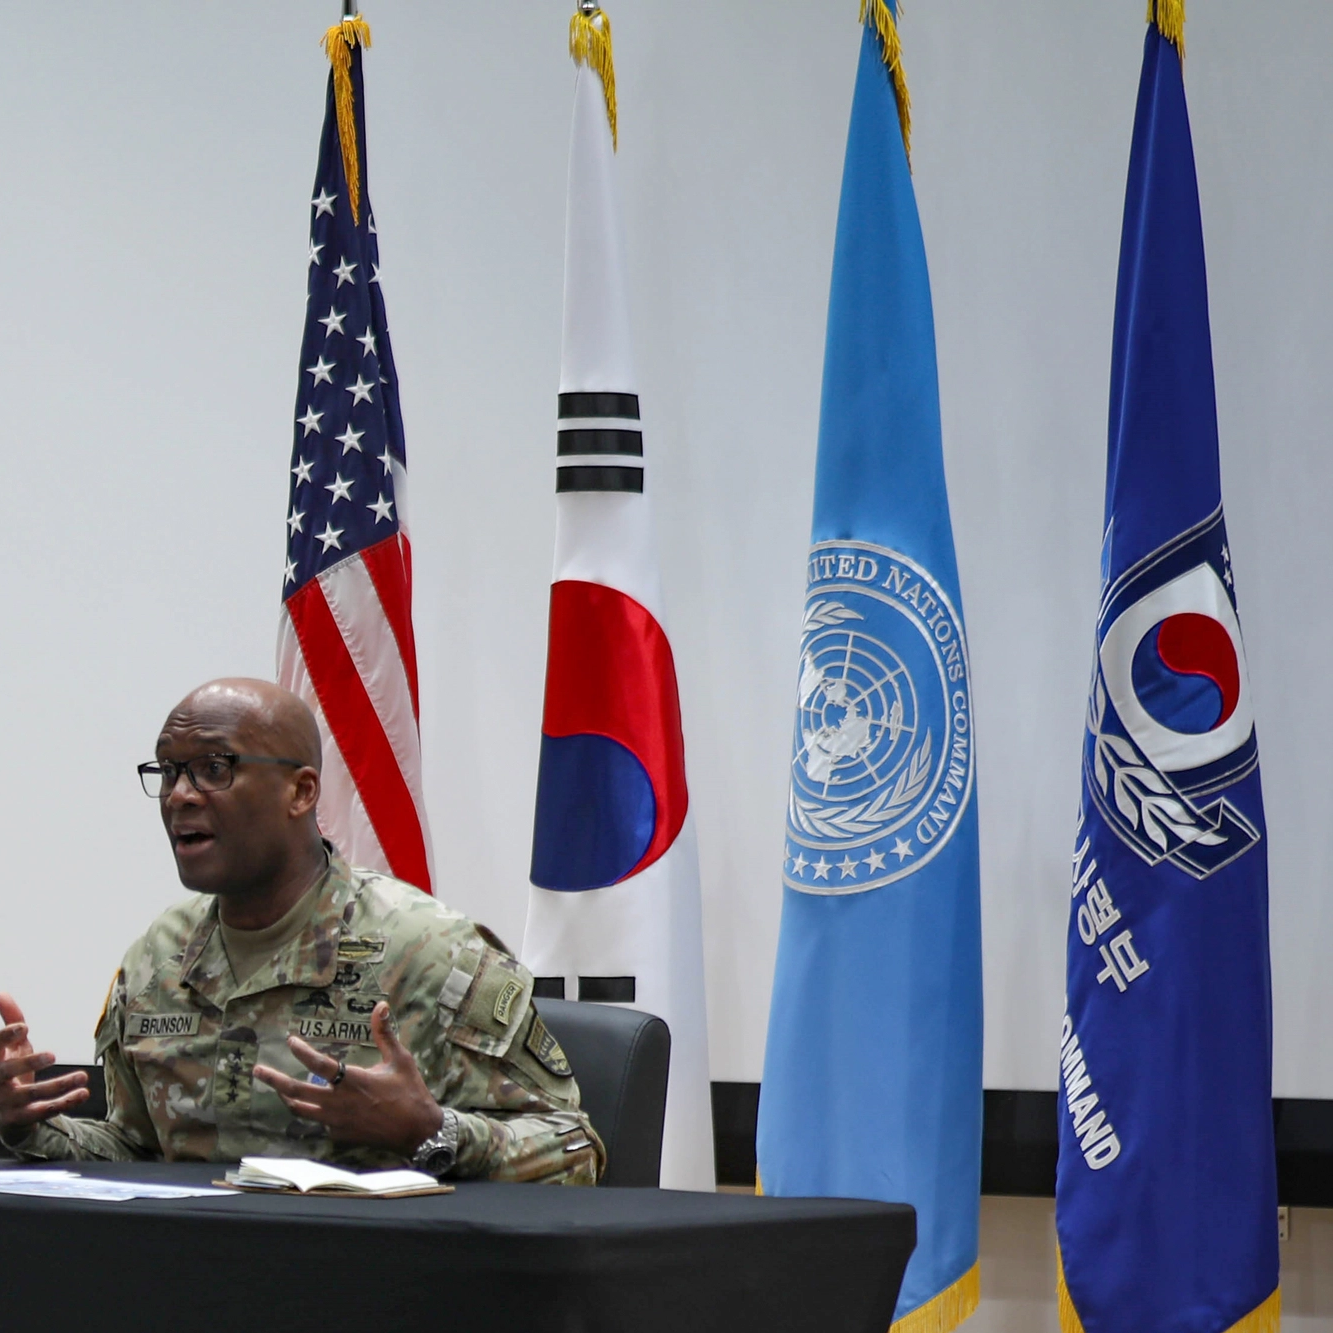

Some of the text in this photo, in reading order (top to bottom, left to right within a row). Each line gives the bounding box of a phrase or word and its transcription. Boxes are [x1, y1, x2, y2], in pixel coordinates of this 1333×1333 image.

[882, 565, 965, 683] NATIONS
[917, 690, 969, 845] COMMAND
[1071, 810, 1150, 993] 사령부
[140, 1017, 193, 1034] BRUNSON
[498, 984, 517, 1017] RANGER
[1060, 998, 1121, 1171] OMMAND
